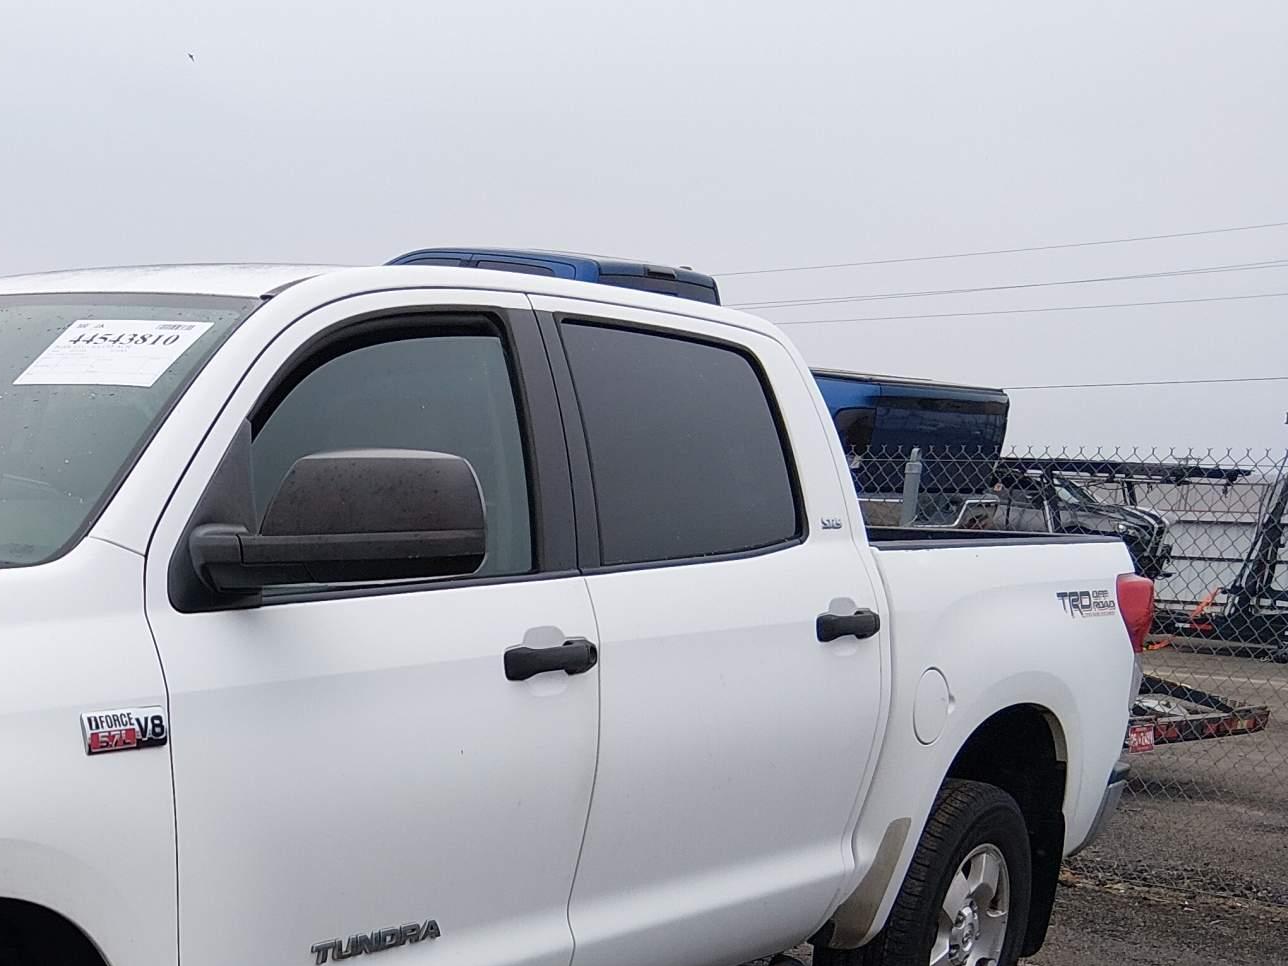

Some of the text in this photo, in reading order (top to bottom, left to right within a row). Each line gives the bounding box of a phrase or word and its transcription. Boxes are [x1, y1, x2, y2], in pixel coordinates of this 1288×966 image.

[69, 333, 180, 345] 44543810
[1092, 590, 1109, 598] OFF
[1056, 590, 1092, 618] TRD
[1093, 600, 1116, 609] ROAD
[135, 715, 165, 741] V8
[310, 919, 441, 965] TUNDRA
